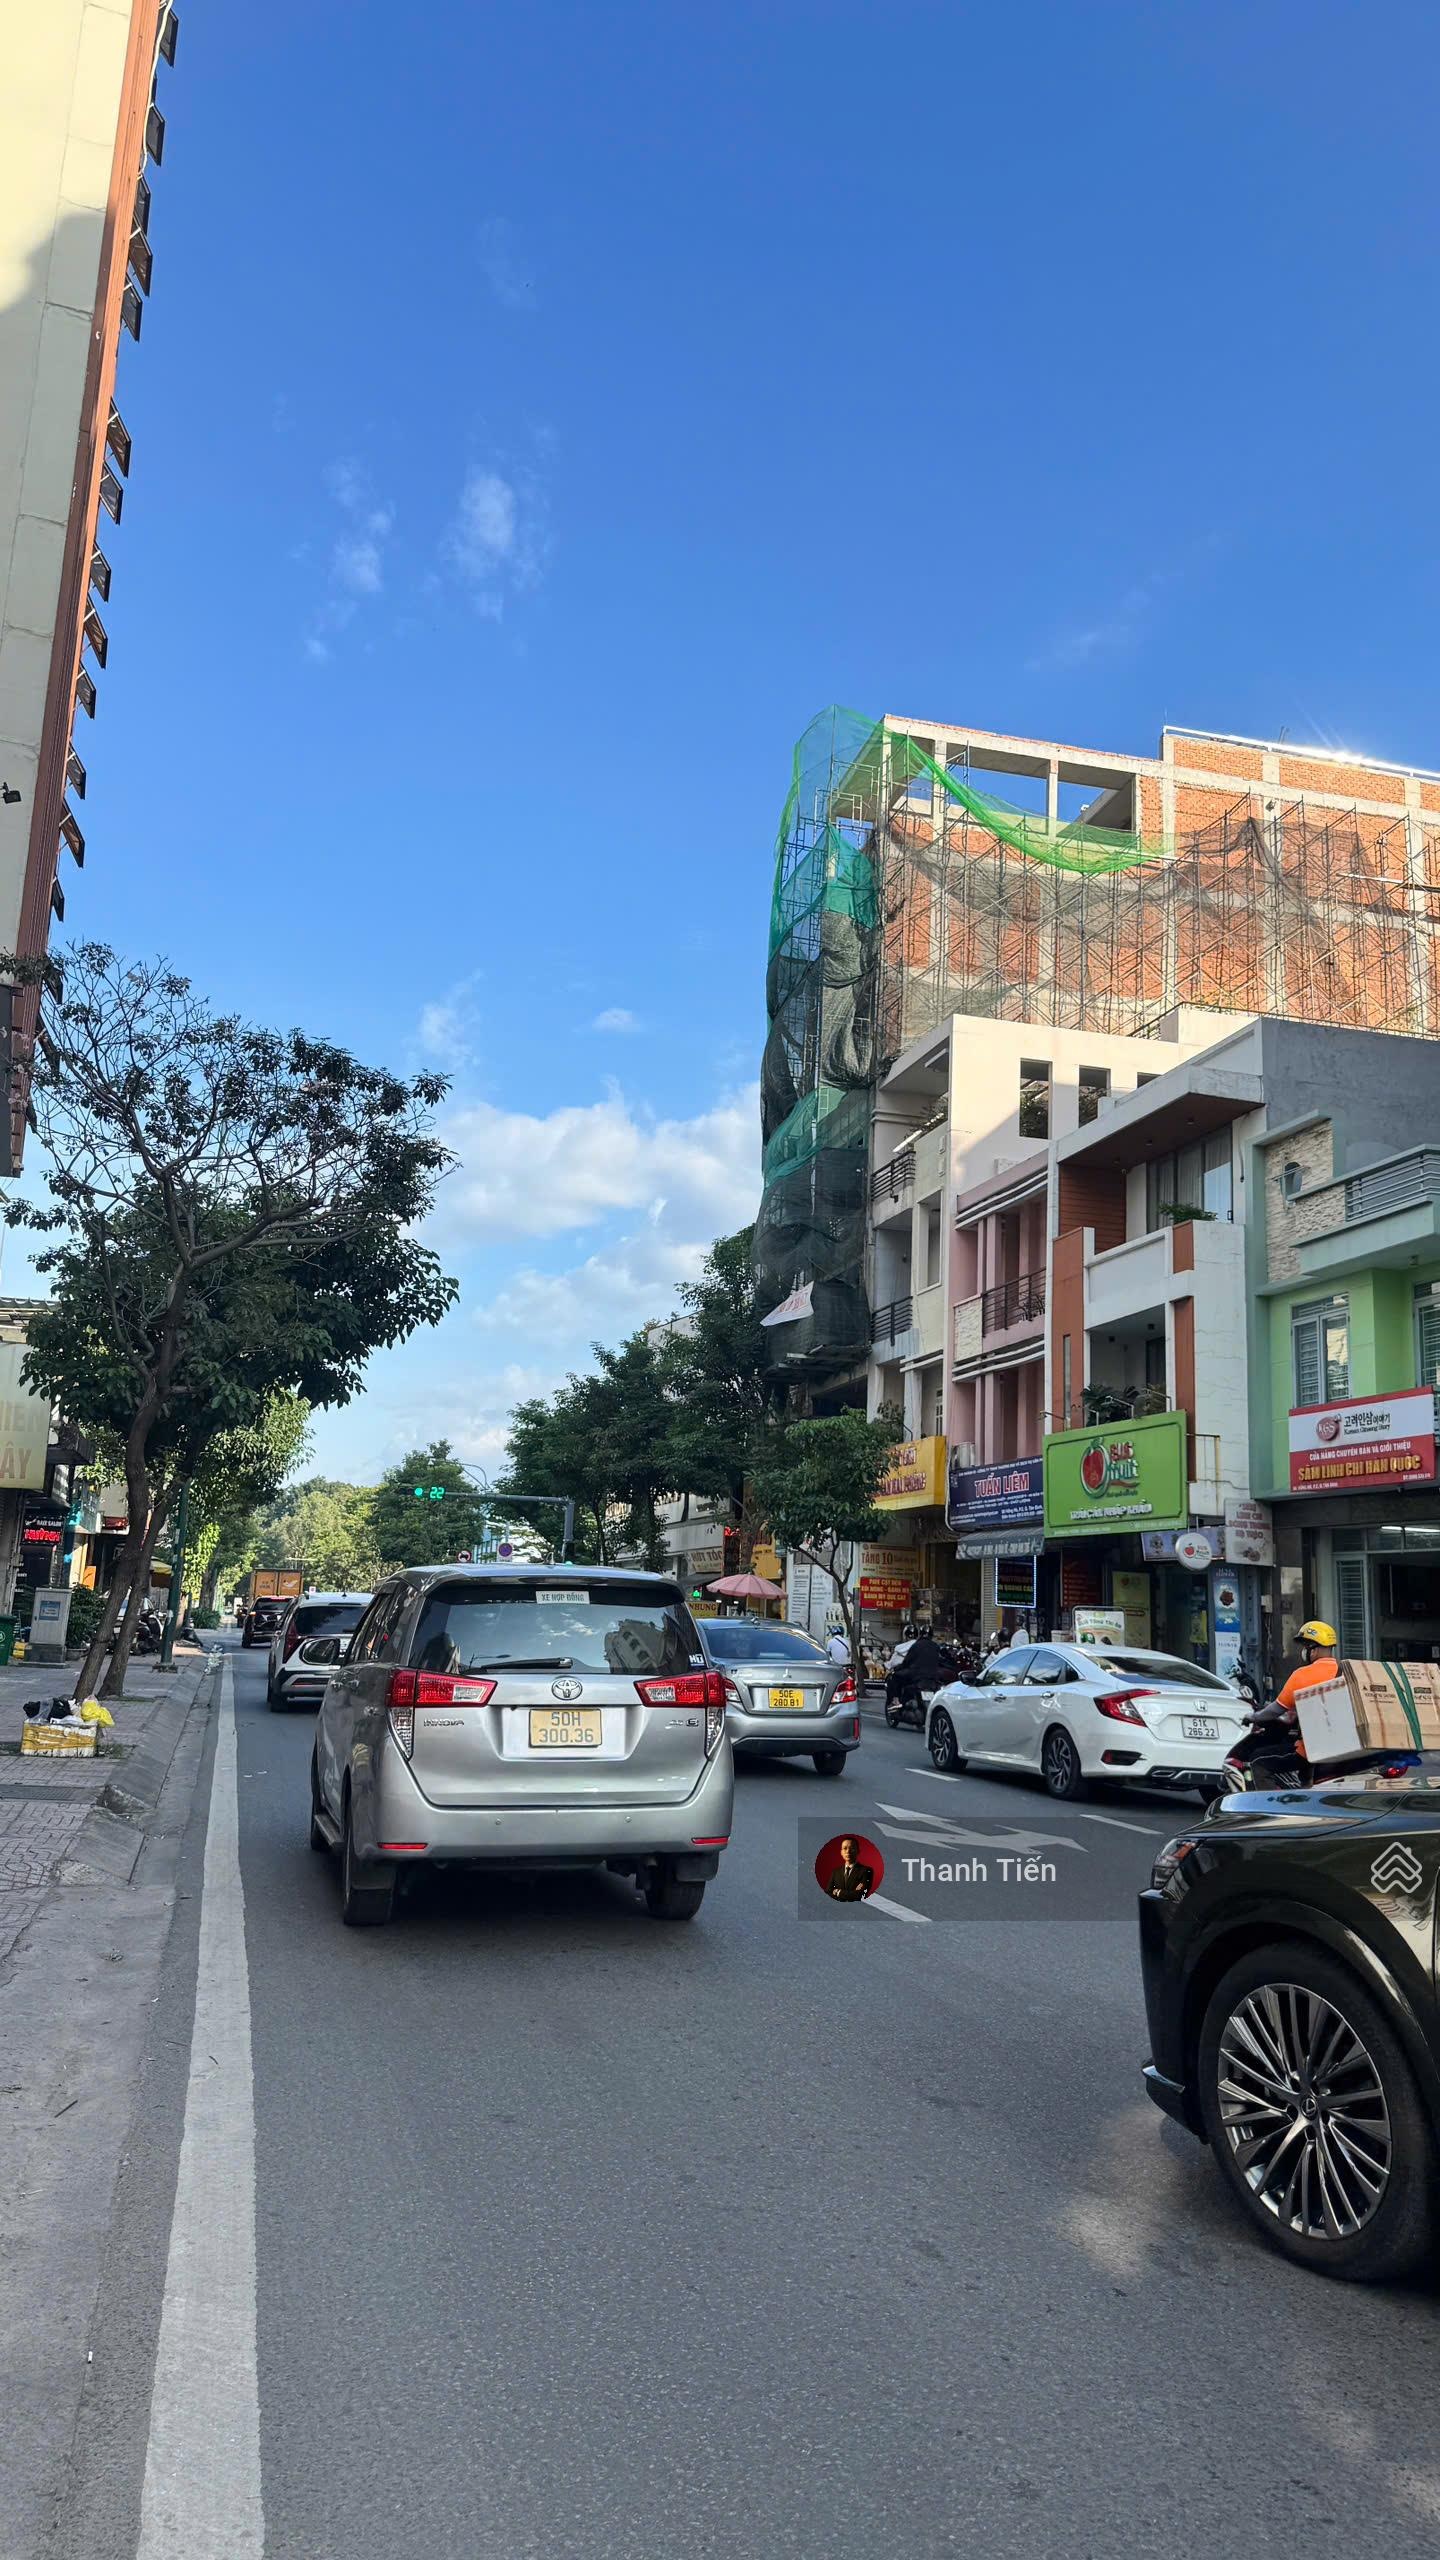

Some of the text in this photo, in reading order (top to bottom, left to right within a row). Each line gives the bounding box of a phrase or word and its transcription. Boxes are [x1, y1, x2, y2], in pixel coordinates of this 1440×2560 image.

[1298, 1453, 1421, 1481] SÂM LINH CHI HÀN QUỐC
[1003, 1470, 1030, 1494] LIÊM
[430, 1486, 445, 1499] 22
[882, 1551, 893, 1565] 10
[541, 1593, 550, 1601] XE
[778, 1689, 793, 1698] 50E
[424, 1719, 465, 1727] INNOVA
[551, 1711, 581, 1726] 50H
[1192, 1718, 1208, 1728] 61K
[538, 1728, 594, 1743] 300.36
